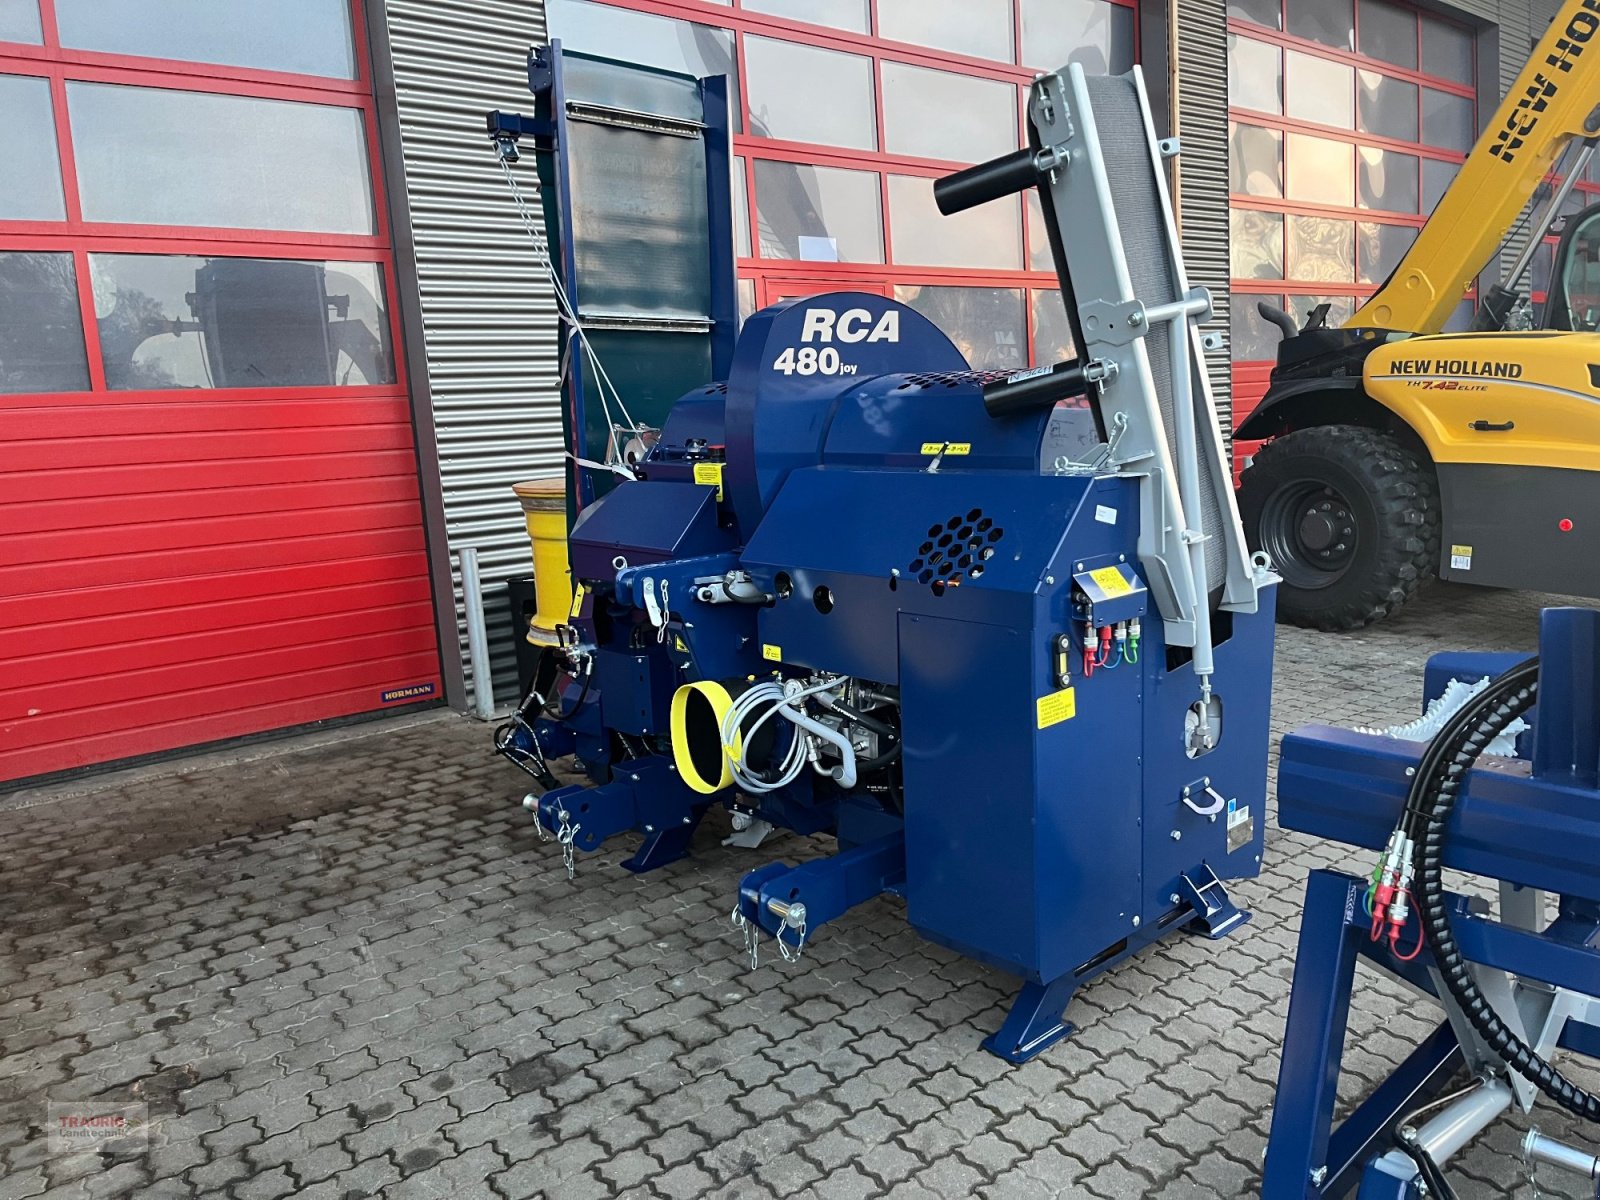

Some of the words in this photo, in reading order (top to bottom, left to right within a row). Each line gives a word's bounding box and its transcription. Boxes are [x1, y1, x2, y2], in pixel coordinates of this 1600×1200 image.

[1489, 73, 1558, 164] NEW
[801, 308, 899, 343] RCA
[1390, 360, 1431, 374] NEW
[1435, 360, 1522, 378] HOLLAND
